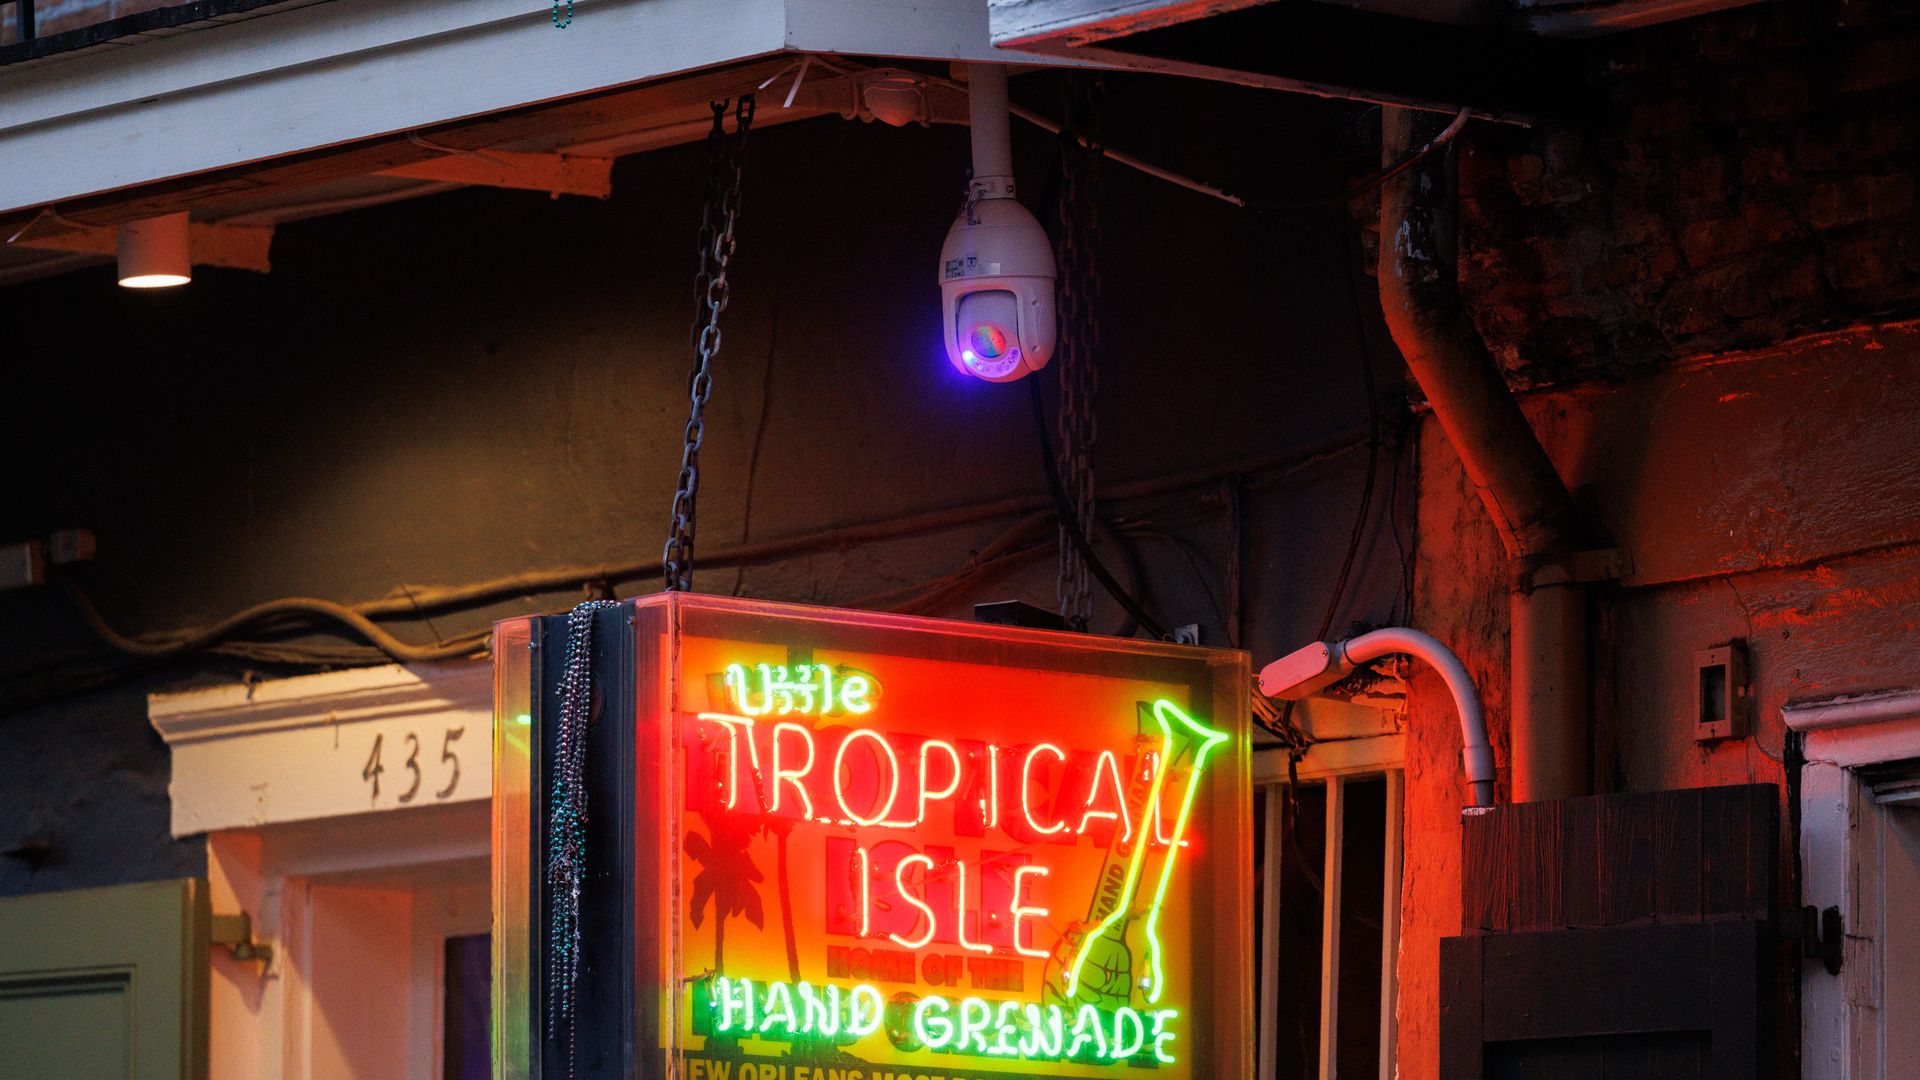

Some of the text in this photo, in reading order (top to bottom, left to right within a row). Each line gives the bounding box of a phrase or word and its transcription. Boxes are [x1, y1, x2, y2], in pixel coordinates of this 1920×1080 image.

[725, 663, 871, 716] Little
[362, 726, 465, 806] 435
[697, 712, 1190, 847] TROPICAL
[856, 846, 1050, 958] ISLE
[921, 952, 964, 987] OF
[714, 975, 1179, 1063] HAND GRENADE
